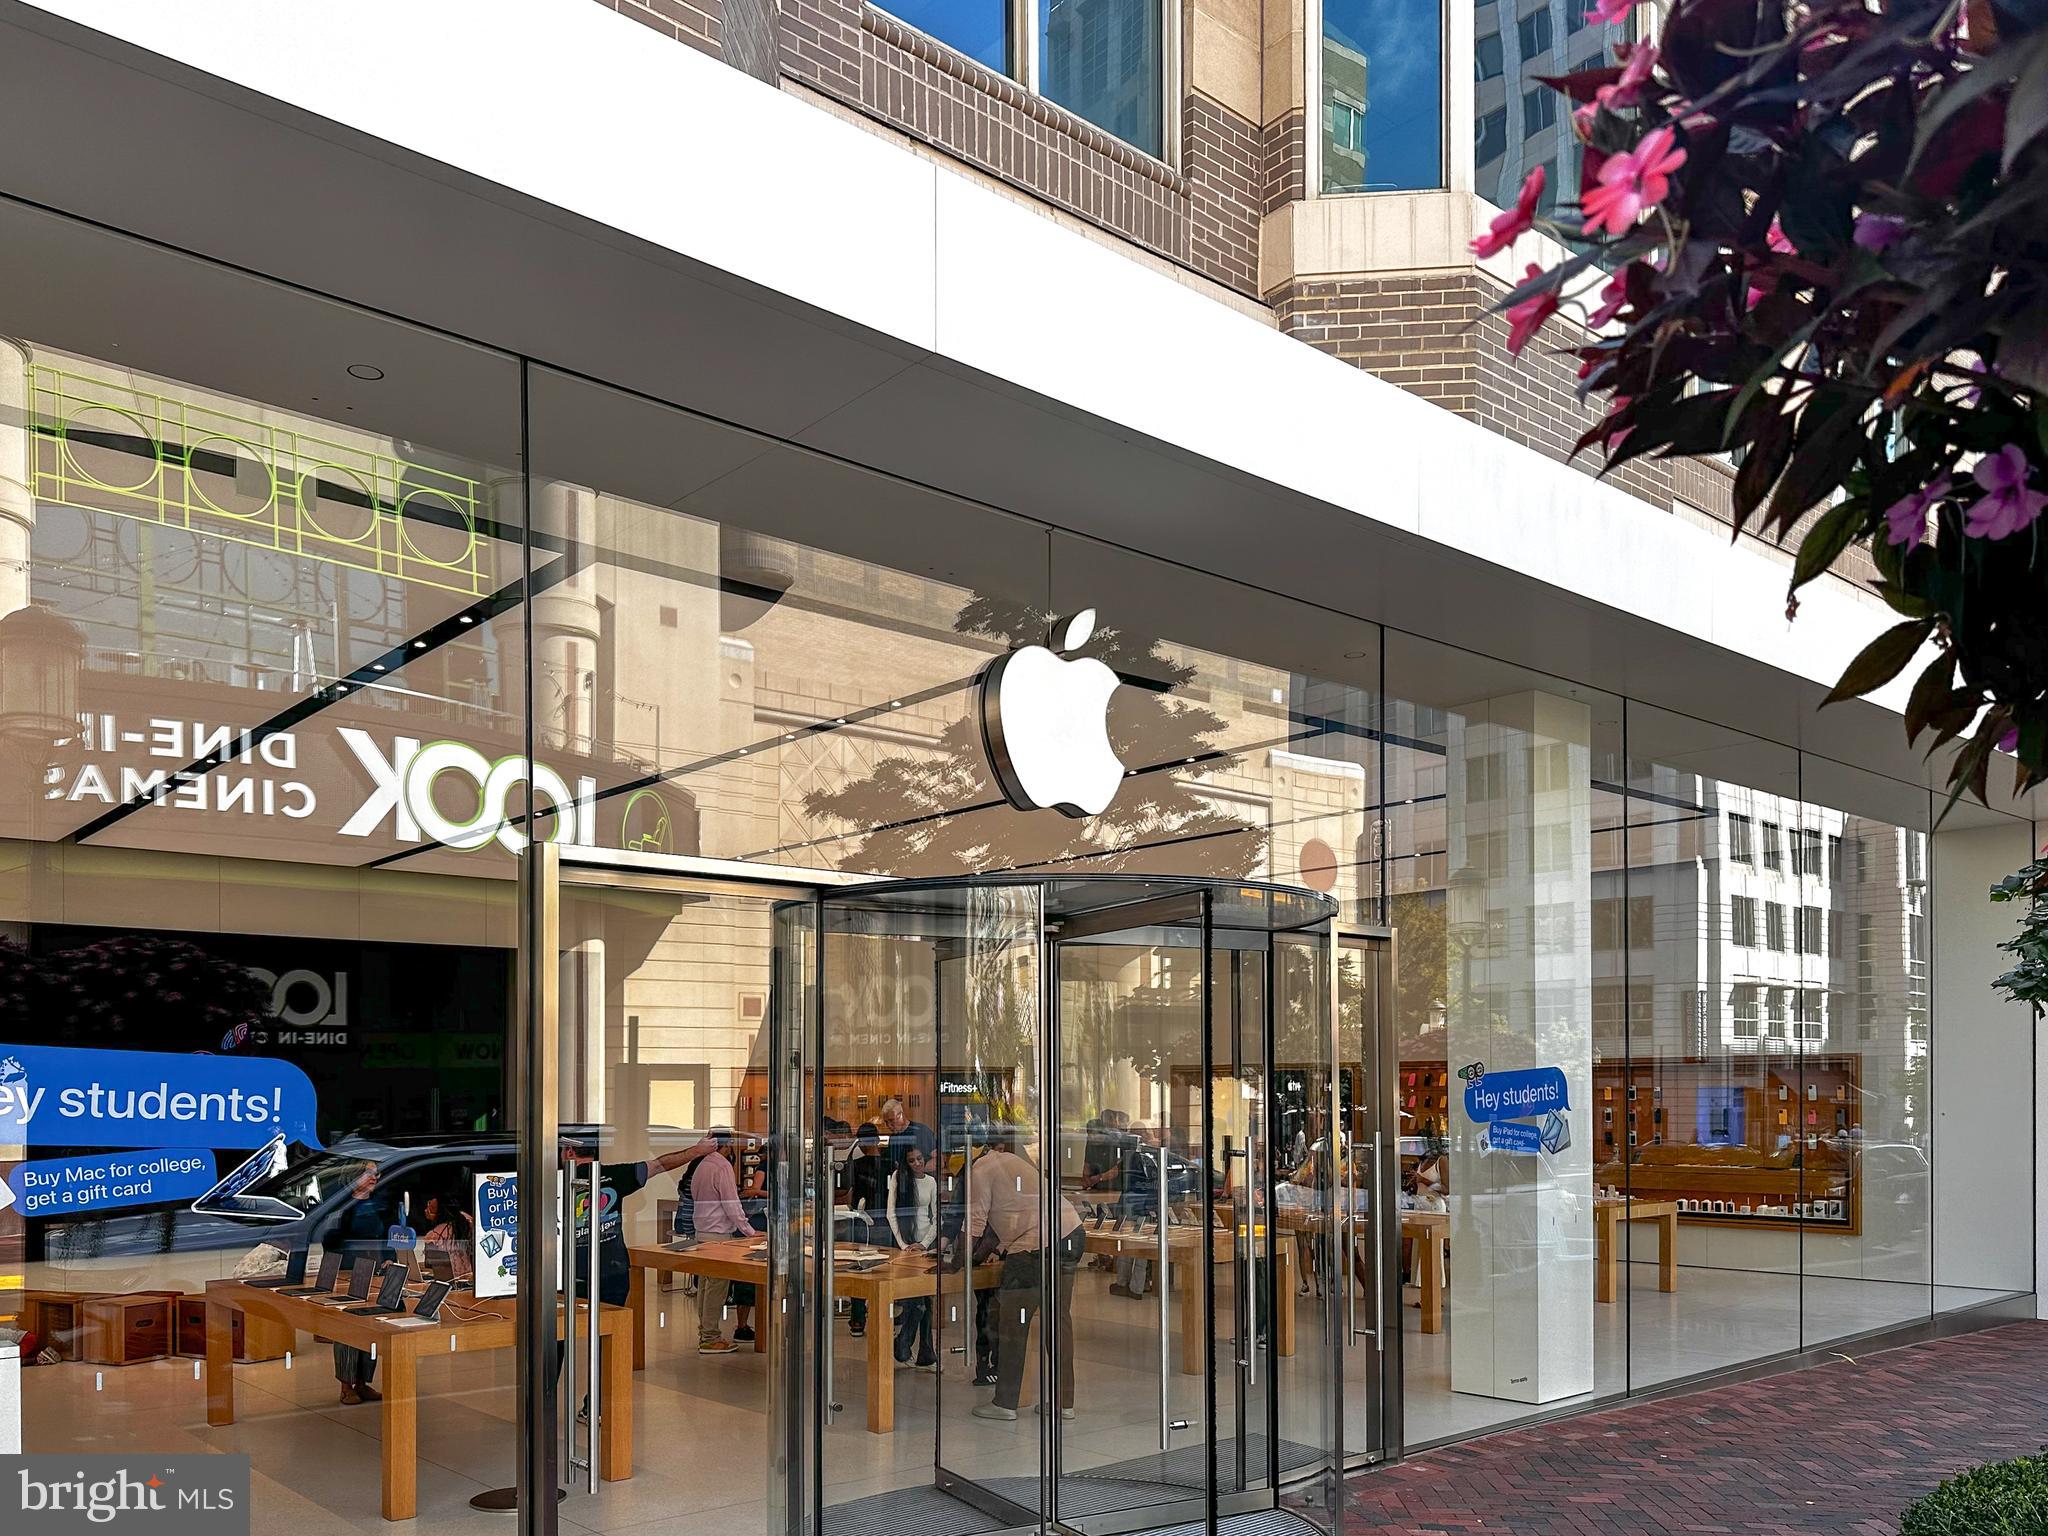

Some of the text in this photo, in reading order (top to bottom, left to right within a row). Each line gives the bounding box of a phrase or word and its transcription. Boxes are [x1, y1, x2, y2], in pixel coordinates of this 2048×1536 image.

[58, 1082, 283, 1123] students!
[1474, 1081, 1559, 1112] Hey students!
[24, 1156, 206, 1189] Buy Mac for college,
[26, 1179, 153, 1210] get a gift card
[487, 1187, 509, 1199] Buy
[489, 1199, 517, 1213] or iPa
[490, 1217, 505, 1227] for
